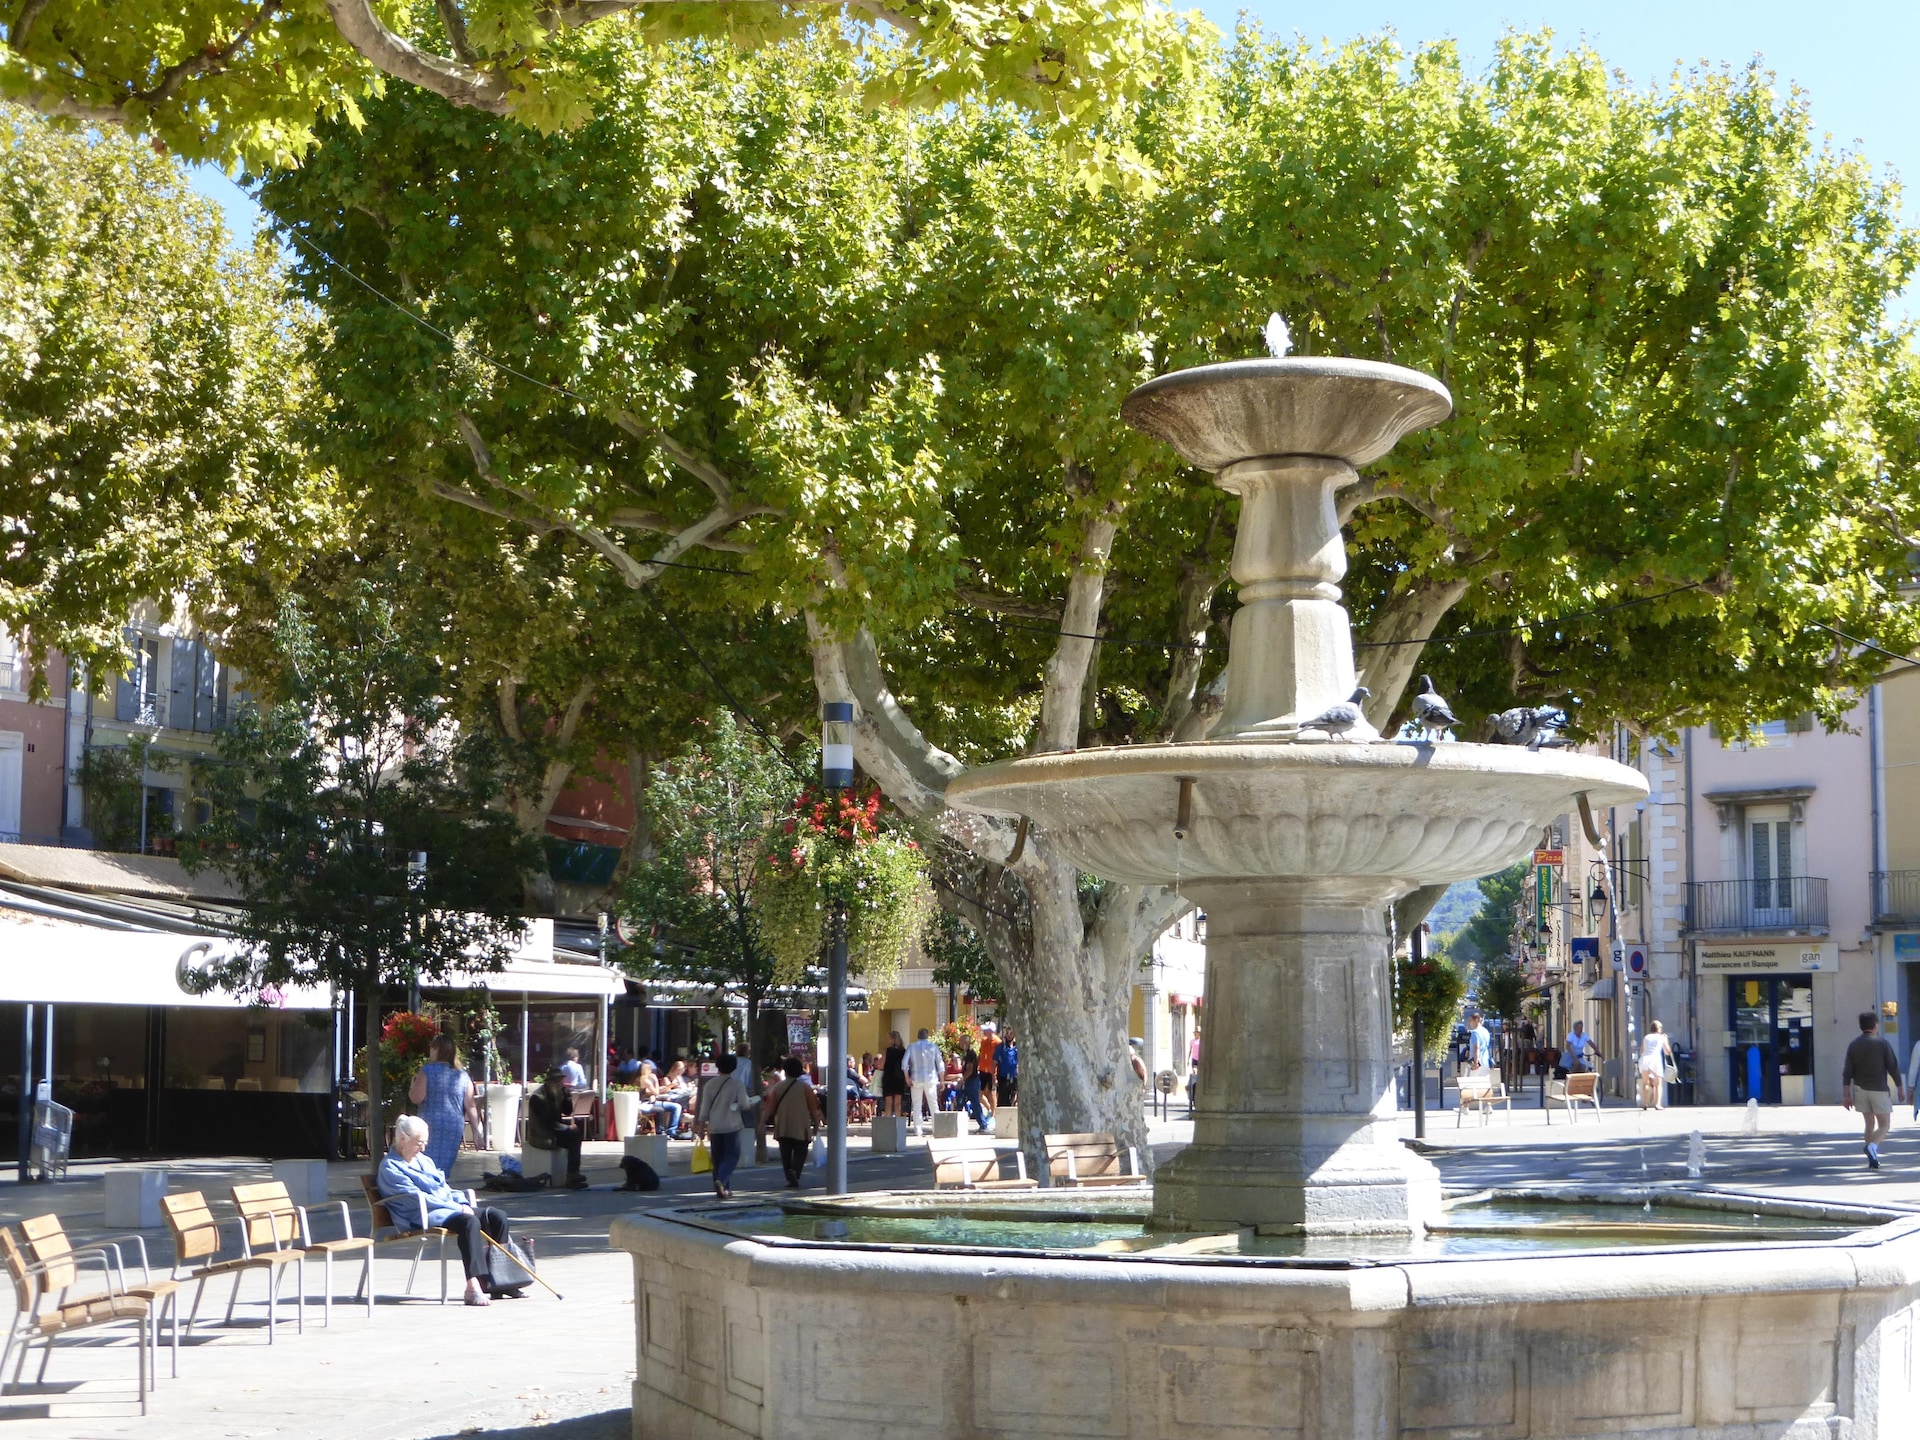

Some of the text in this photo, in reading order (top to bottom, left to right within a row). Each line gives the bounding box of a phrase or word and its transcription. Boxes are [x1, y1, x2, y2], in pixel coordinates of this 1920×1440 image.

[1535, 851, 1564, 864] Pizza
[1572, 949, 1592, 960] AXA
[1701, 950, 1776, 959] Matthieu KAUFMANN
[1801, 952, 1821, 963] gan
[1701, 961, 1742, 969] Assurances
[1751, 961, 1779, 969] Banque
